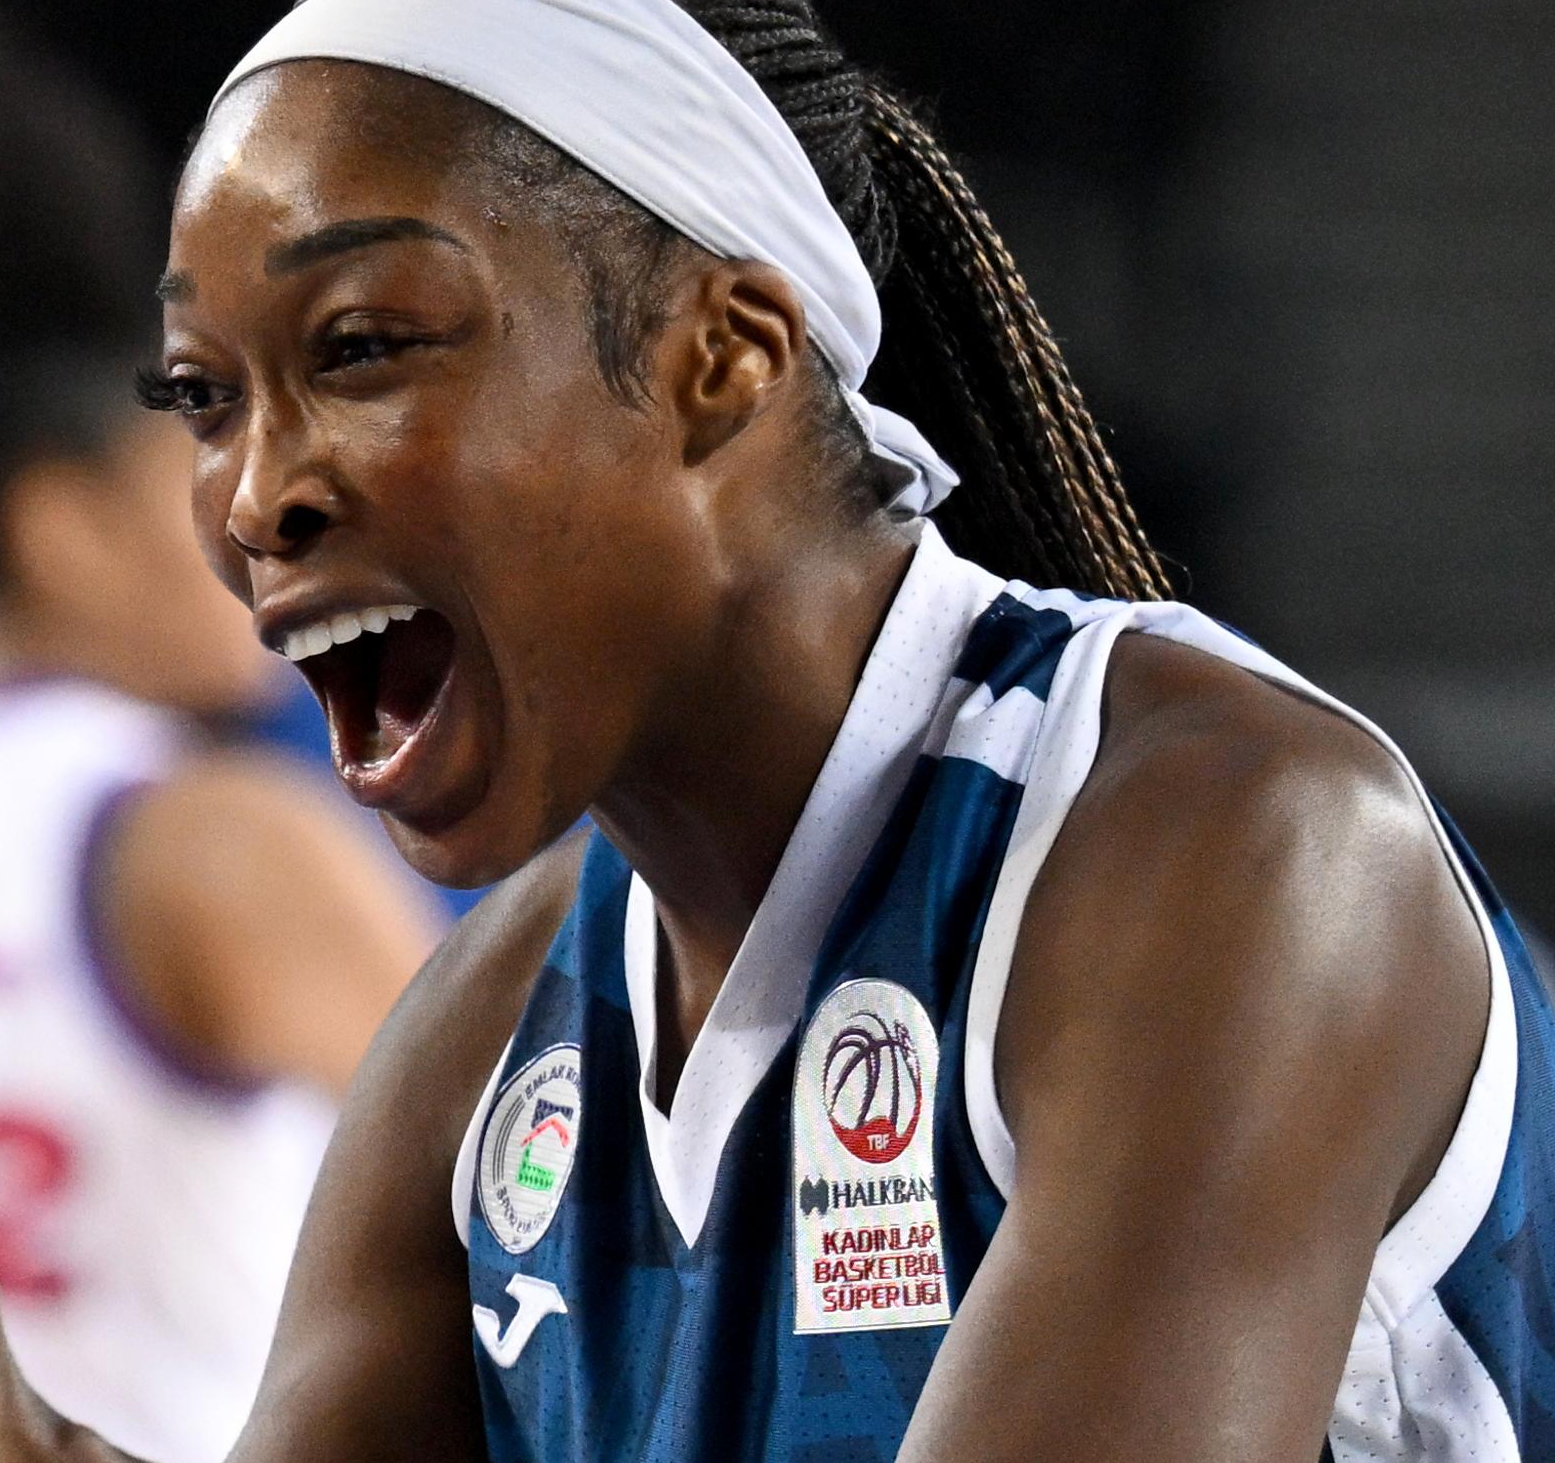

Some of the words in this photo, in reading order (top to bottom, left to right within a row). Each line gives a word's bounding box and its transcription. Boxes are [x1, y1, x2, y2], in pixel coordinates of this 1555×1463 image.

[866, 1133, 891, 1151] TBF
[832, 1176, 936, 1209] HALKBAN
[822, 1222, 936, 1255] KADINLAR
[814, 1251, 947, 1284] BASKETBOL
